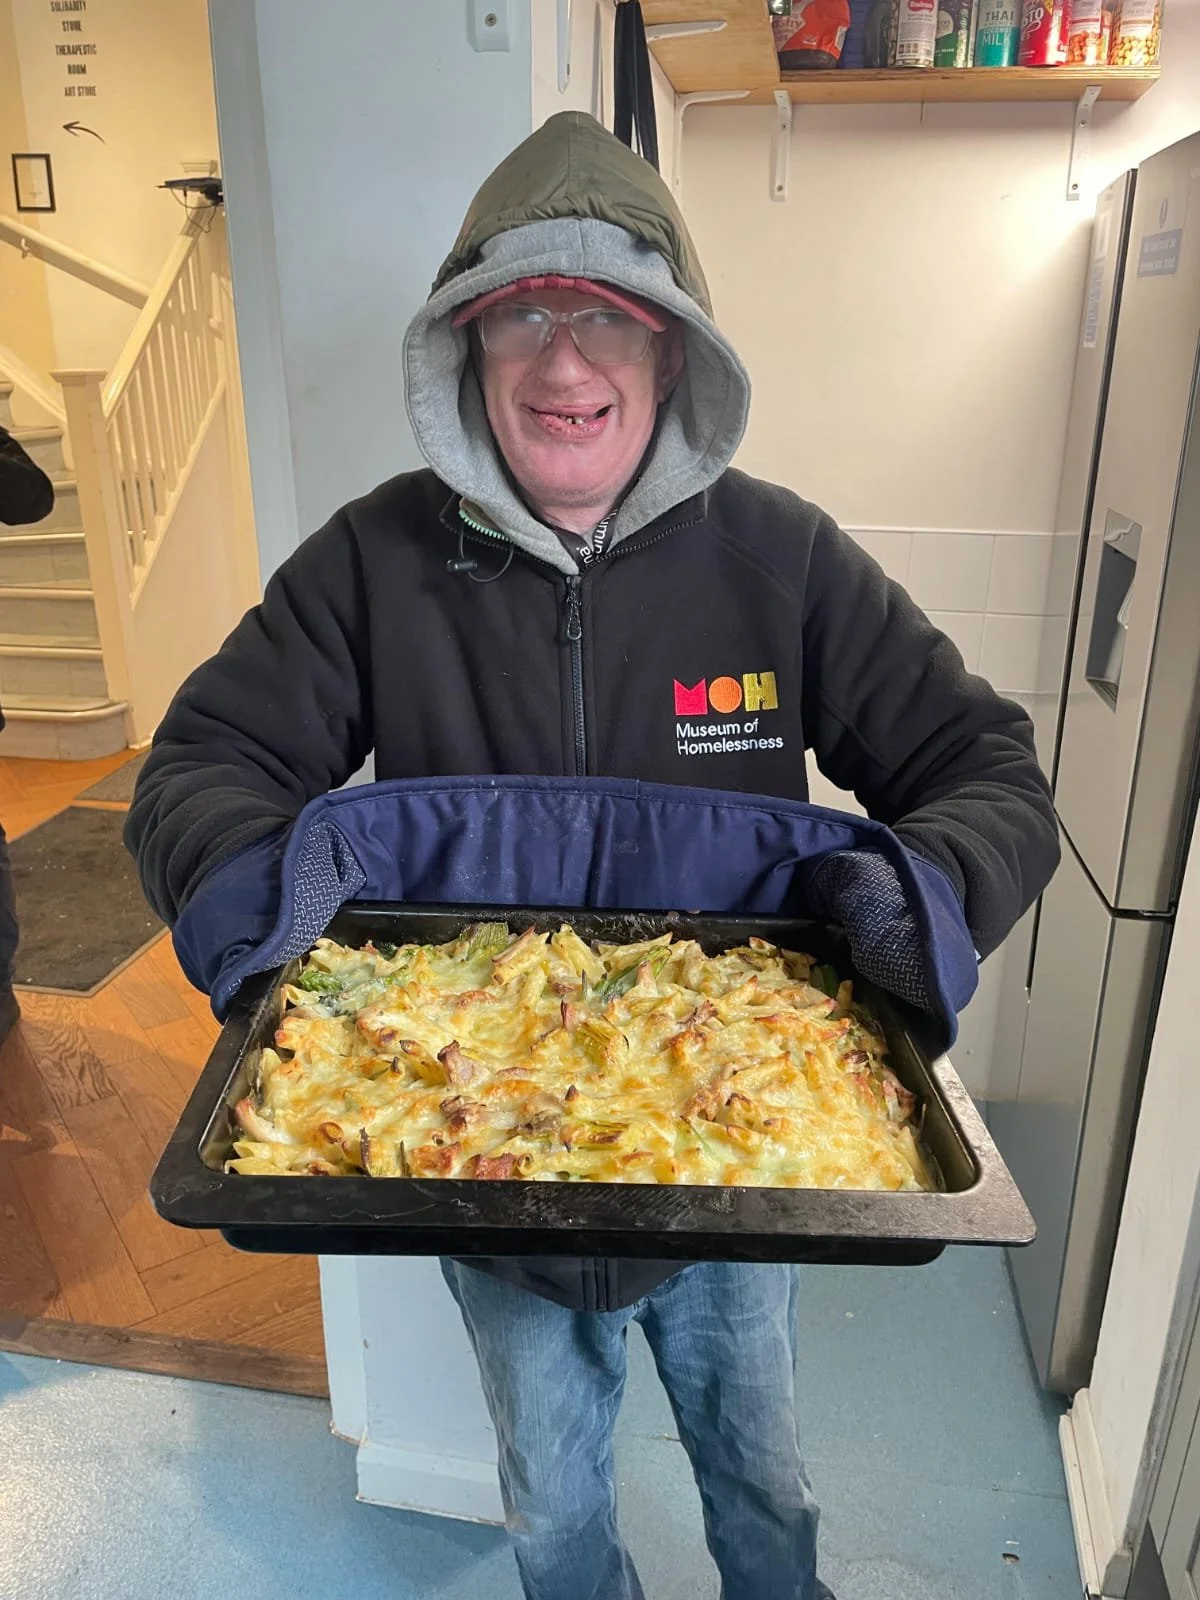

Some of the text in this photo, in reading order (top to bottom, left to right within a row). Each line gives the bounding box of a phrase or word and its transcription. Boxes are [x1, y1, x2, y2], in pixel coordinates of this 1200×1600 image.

[985, 11, 1014, 21] THAI
[62, 20, 82, 32] STORE
[982, 31, 1011, 47] MILK
[55, 44, 97, 56] THERAPEUTIC
[67, 64, 87, 75] ROOM
[64, 86, 97, 97] ART STORE
[673, 671, 779, 715] MOH
[676, 718, 759, 739] Museum of
[677, 737, 784, 755] Homelessness
